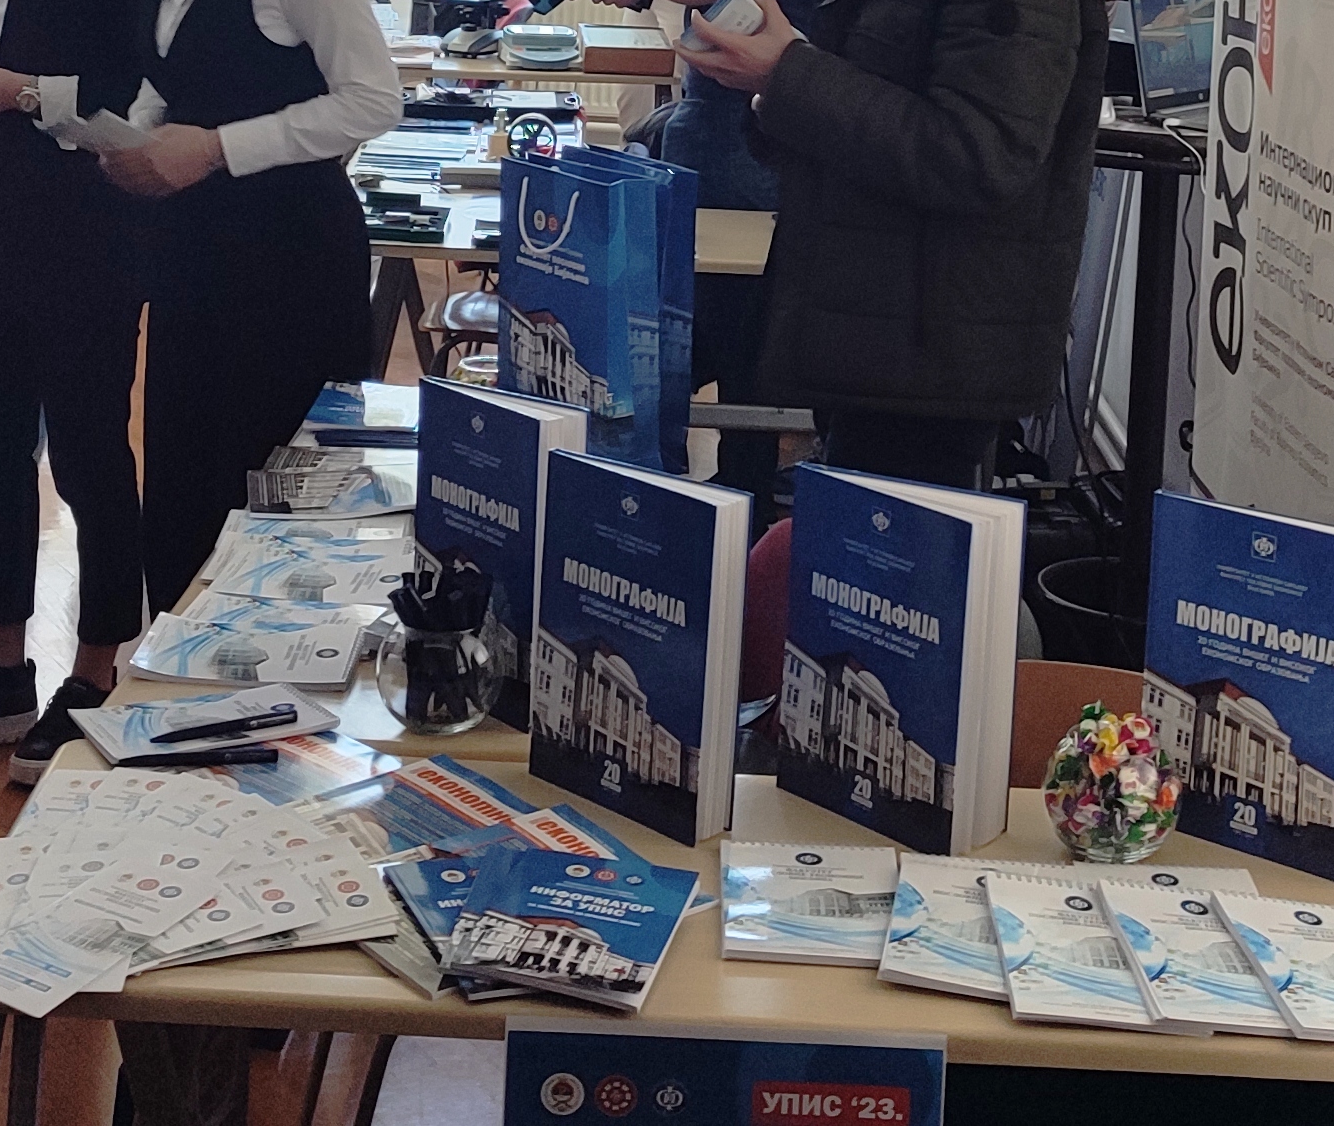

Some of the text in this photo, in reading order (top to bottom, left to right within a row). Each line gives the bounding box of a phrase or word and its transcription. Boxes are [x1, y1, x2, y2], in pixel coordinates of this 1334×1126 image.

[431, 475, 519, 532] МОНОГРАФИЈА
[563, 556, 686, 627] МОНОГРАФИЈА
[811, 571, 940, 645] МОНОГРАФИЈА
[602, 759, 621, 784] 20
[854, 774, 872, 800] 20
[1233, 801, 1257, 826] 20
[530, 885, 655, 914] ИНФОРМАТОР
[550, 896, 574, 908] ЗА
[576, 901, 626, 917] УПИС
[762, 1091, 842, 1117] УПИС
